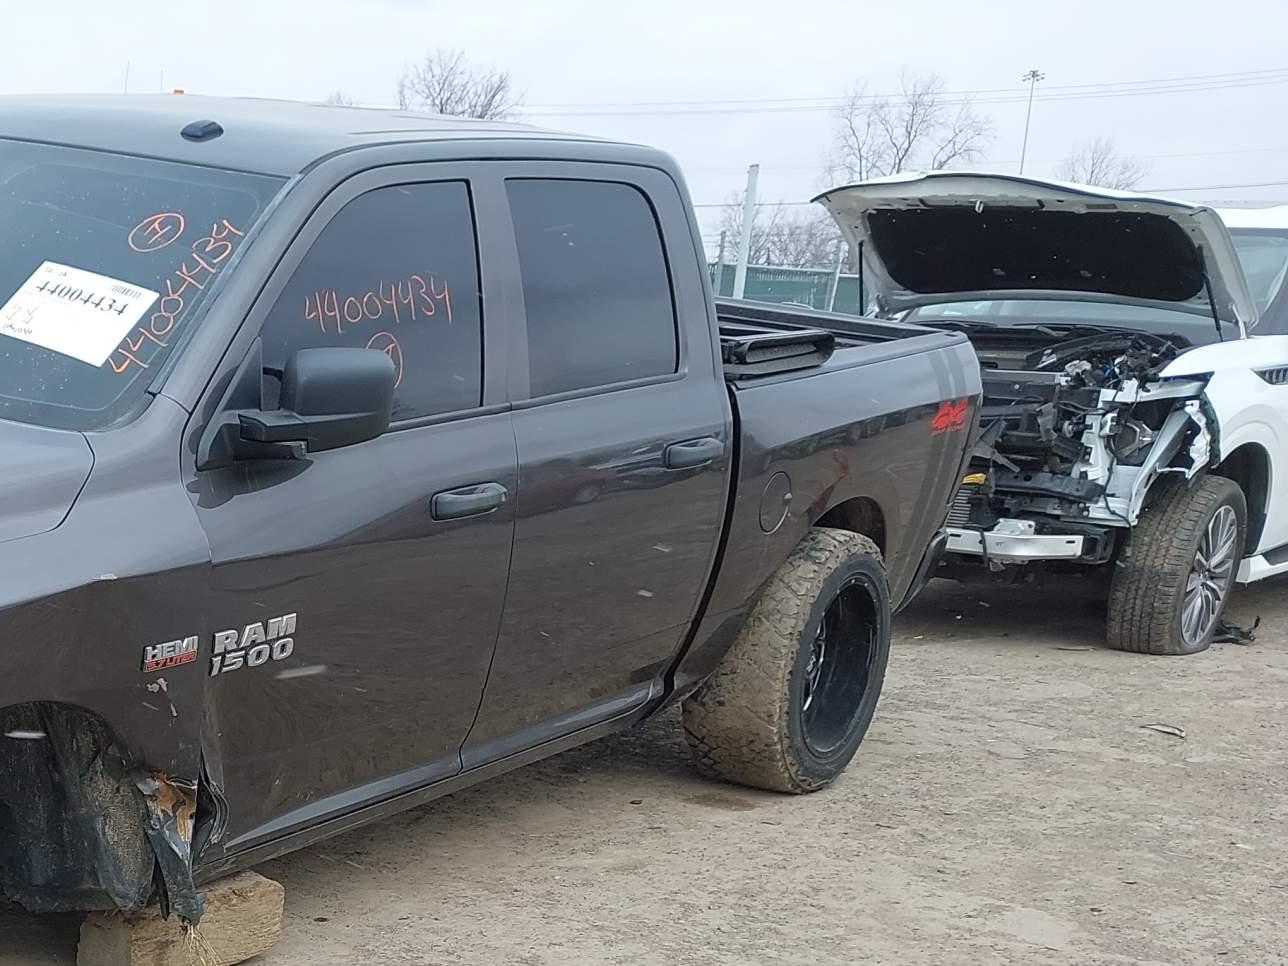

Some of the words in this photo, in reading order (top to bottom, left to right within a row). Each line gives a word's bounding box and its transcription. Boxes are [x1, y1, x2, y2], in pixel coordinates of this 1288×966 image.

[36, 280, 129, 317] 44004434
[108, 219, 245, 374] 44004434
[304, 275, 453, 335] 44004434
[144, 635, 199, 662] HEMI
[213, 612, 298, 654] RAM
[210, 637, 295, 677] 1500
